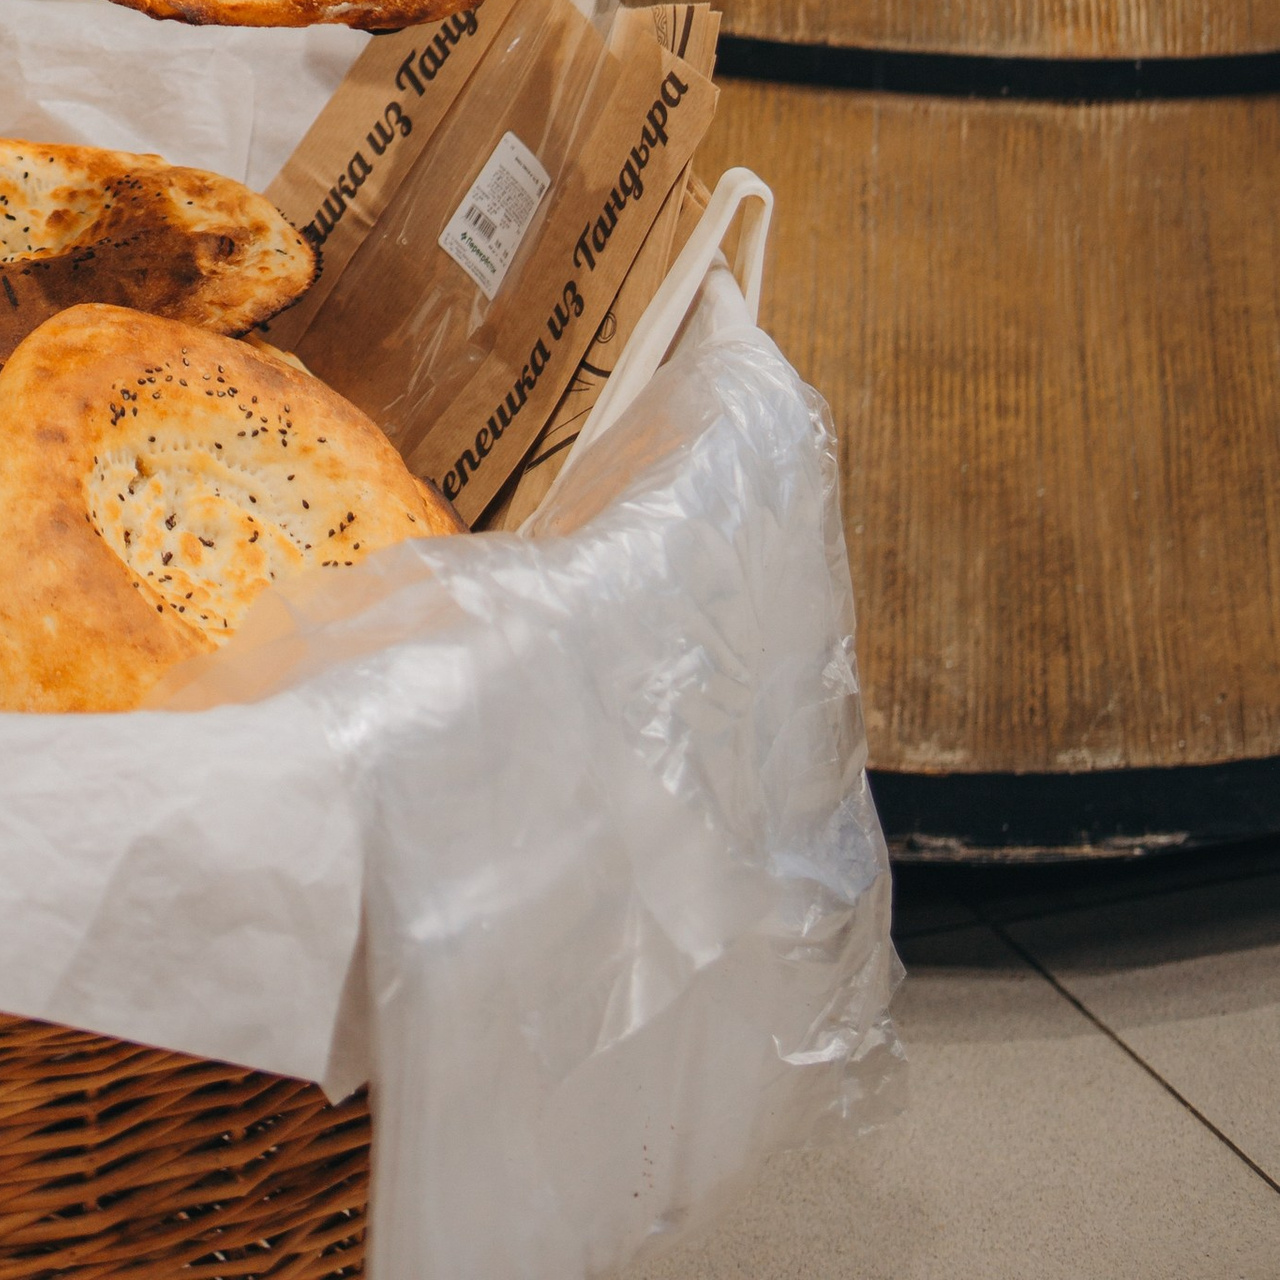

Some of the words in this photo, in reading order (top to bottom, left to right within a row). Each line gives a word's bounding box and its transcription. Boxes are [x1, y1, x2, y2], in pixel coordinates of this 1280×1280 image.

[366, 101, 413, 156] из
[395, 5, 479, 97] Танд
[433, 337, 552, 502] епешка
[547, 280, 585, 340] из
[572, 70, 689, 272] Тандыра
